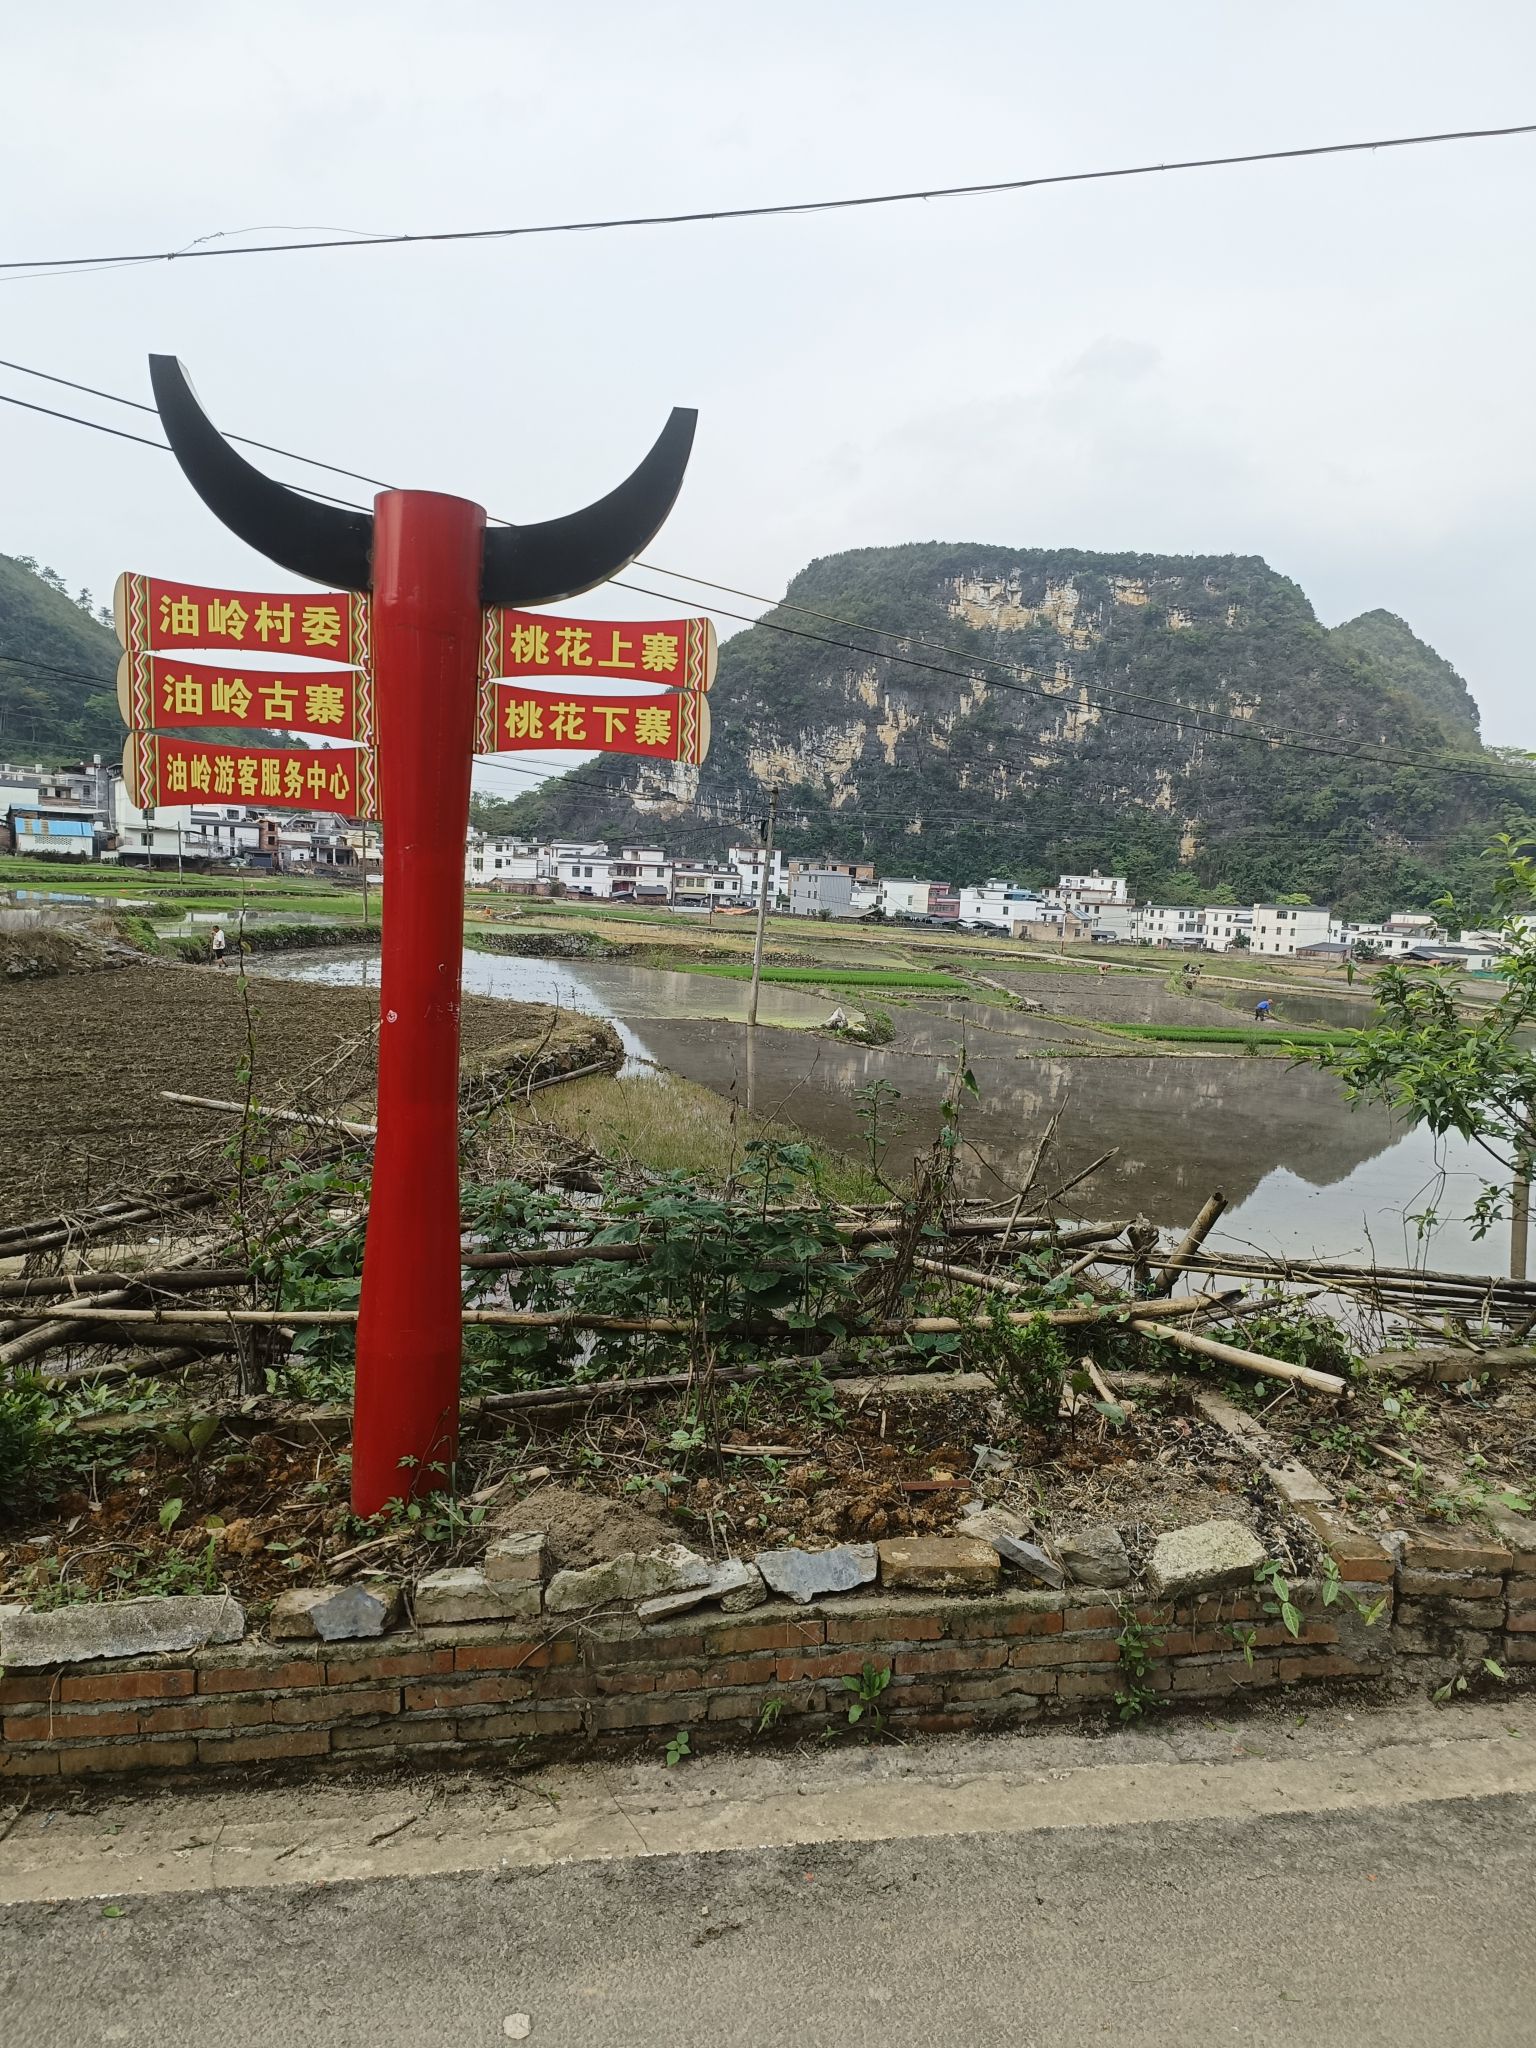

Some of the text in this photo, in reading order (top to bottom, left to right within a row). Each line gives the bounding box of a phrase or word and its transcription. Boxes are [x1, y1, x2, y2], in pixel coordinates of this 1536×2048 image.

[159, 595, 341, 647] 油岭村委
[510, 624, 679, 672] 桃花上寨
[162, 674, 345, 724] 油岭古寨
[504, 699, 672, 746] 桃花下寨
[167, 752, 350, 800] 油岭游客服务中心
